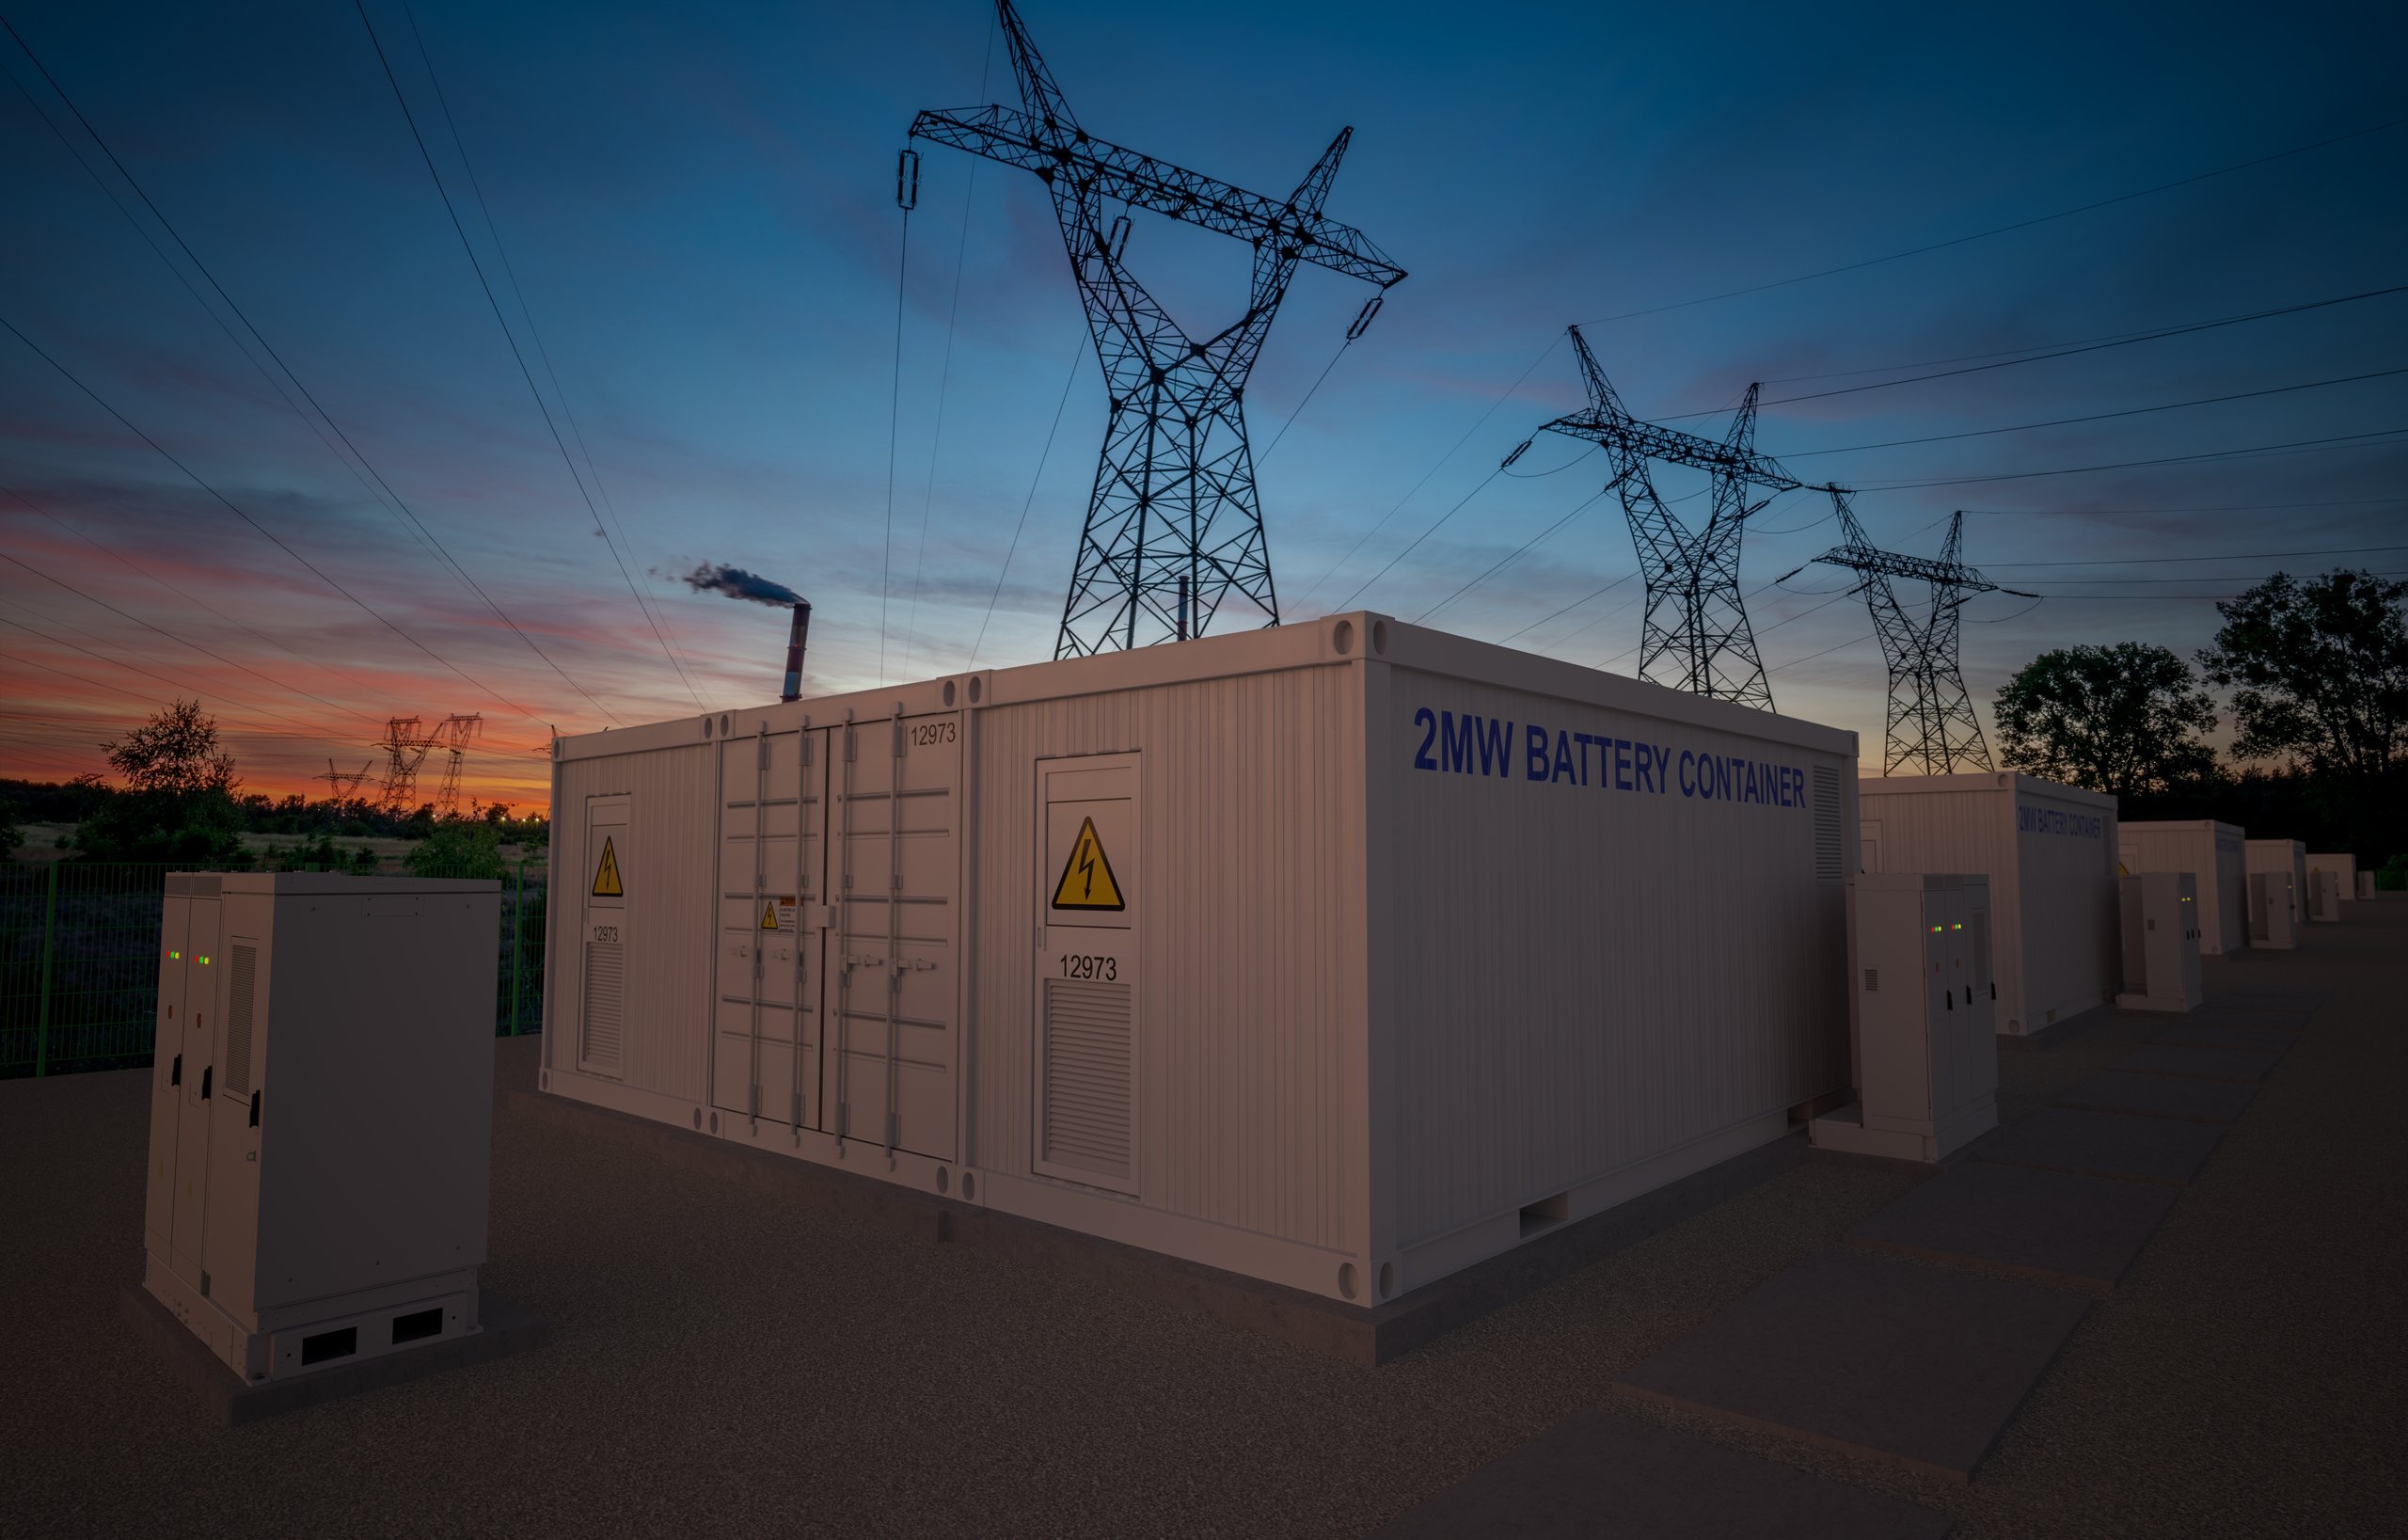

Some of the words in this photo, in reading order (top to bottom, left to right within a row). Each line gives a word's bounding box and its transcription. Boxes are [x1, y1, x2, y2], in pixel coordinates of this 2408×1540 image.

[911, 722, 956, 746] 12973
[1414, 706, 1513, 779] 2MW
[1527, 724, 1671, 795] BATTERY
[1678, 750, 1806, 809] CONTAINER
[2038, 808, 2067, 835] BATTERY
[594, 926, 618, 943] 12973
[1060, 954, 1117, 981] 12973
